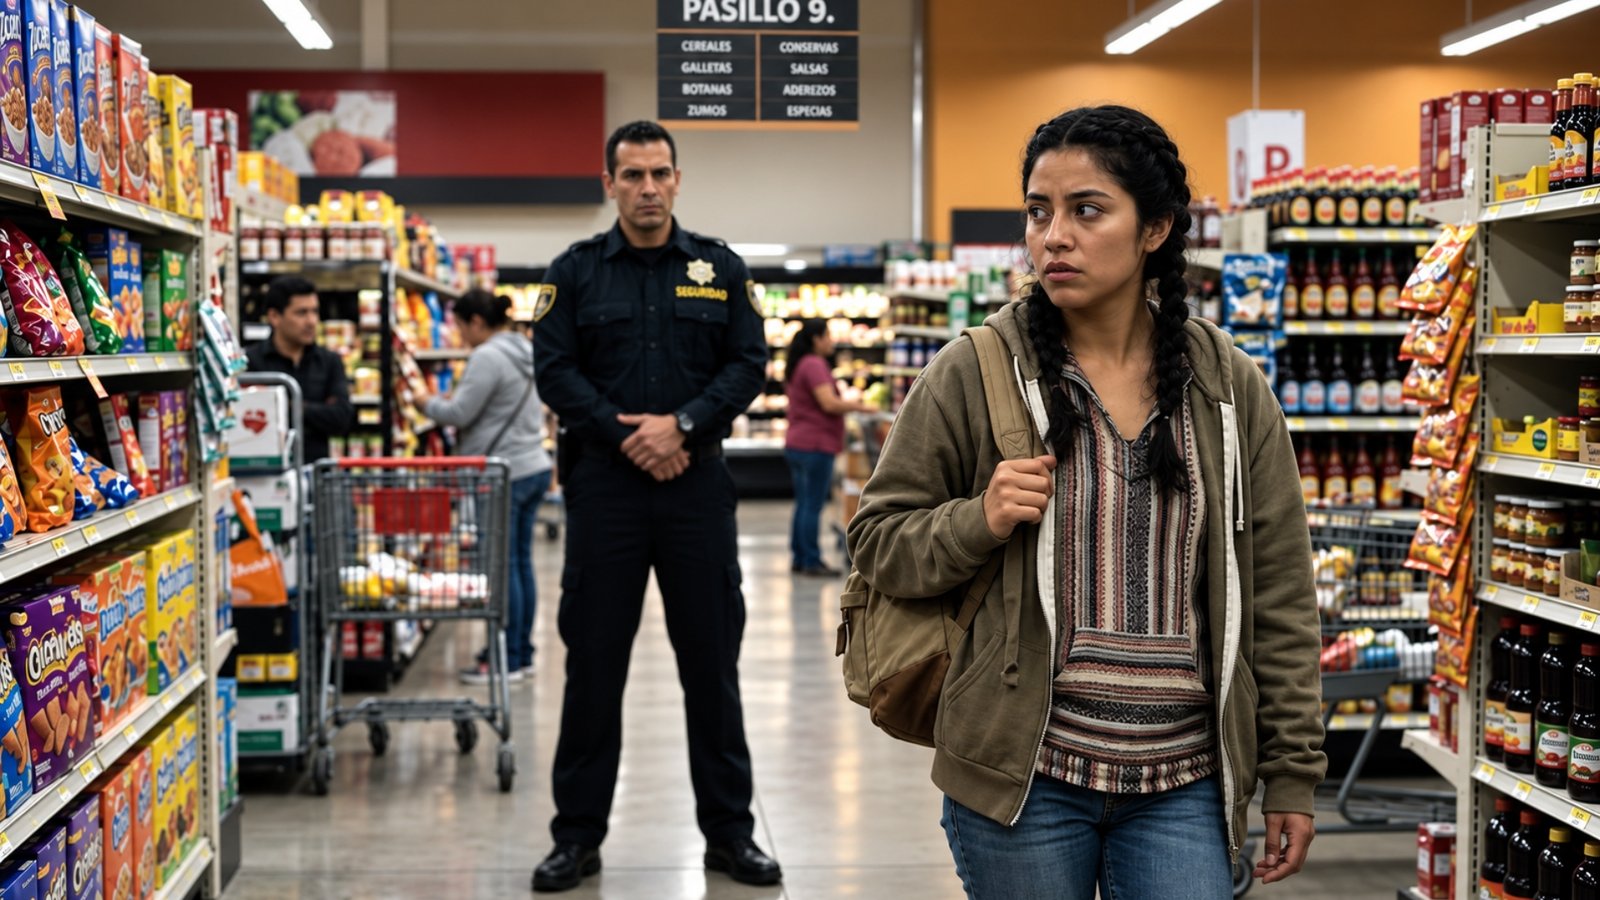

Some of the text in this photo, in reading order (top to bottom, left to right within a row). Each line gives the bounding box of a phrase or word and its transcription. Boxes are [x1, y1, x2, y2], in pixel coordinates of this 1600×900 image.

[682, 0, 836, 24] PASILLO 9.
[681, 40, 732, 53] CEREALES
[779, 41, 839, 54] CONSERVAS
[681, 62, 732, 74] GALLETAS
[790, 63, 829, 75] SALSAS
[682, 83, 733, 95] BOTANAS
[782, 84, 837, 97] ADEREZOS
[687, 105, 727, 117] ZUMOS
[786, 105, 833, 118] ESPECIAS
[675, 285, 728, 301] SEGURIDAD
